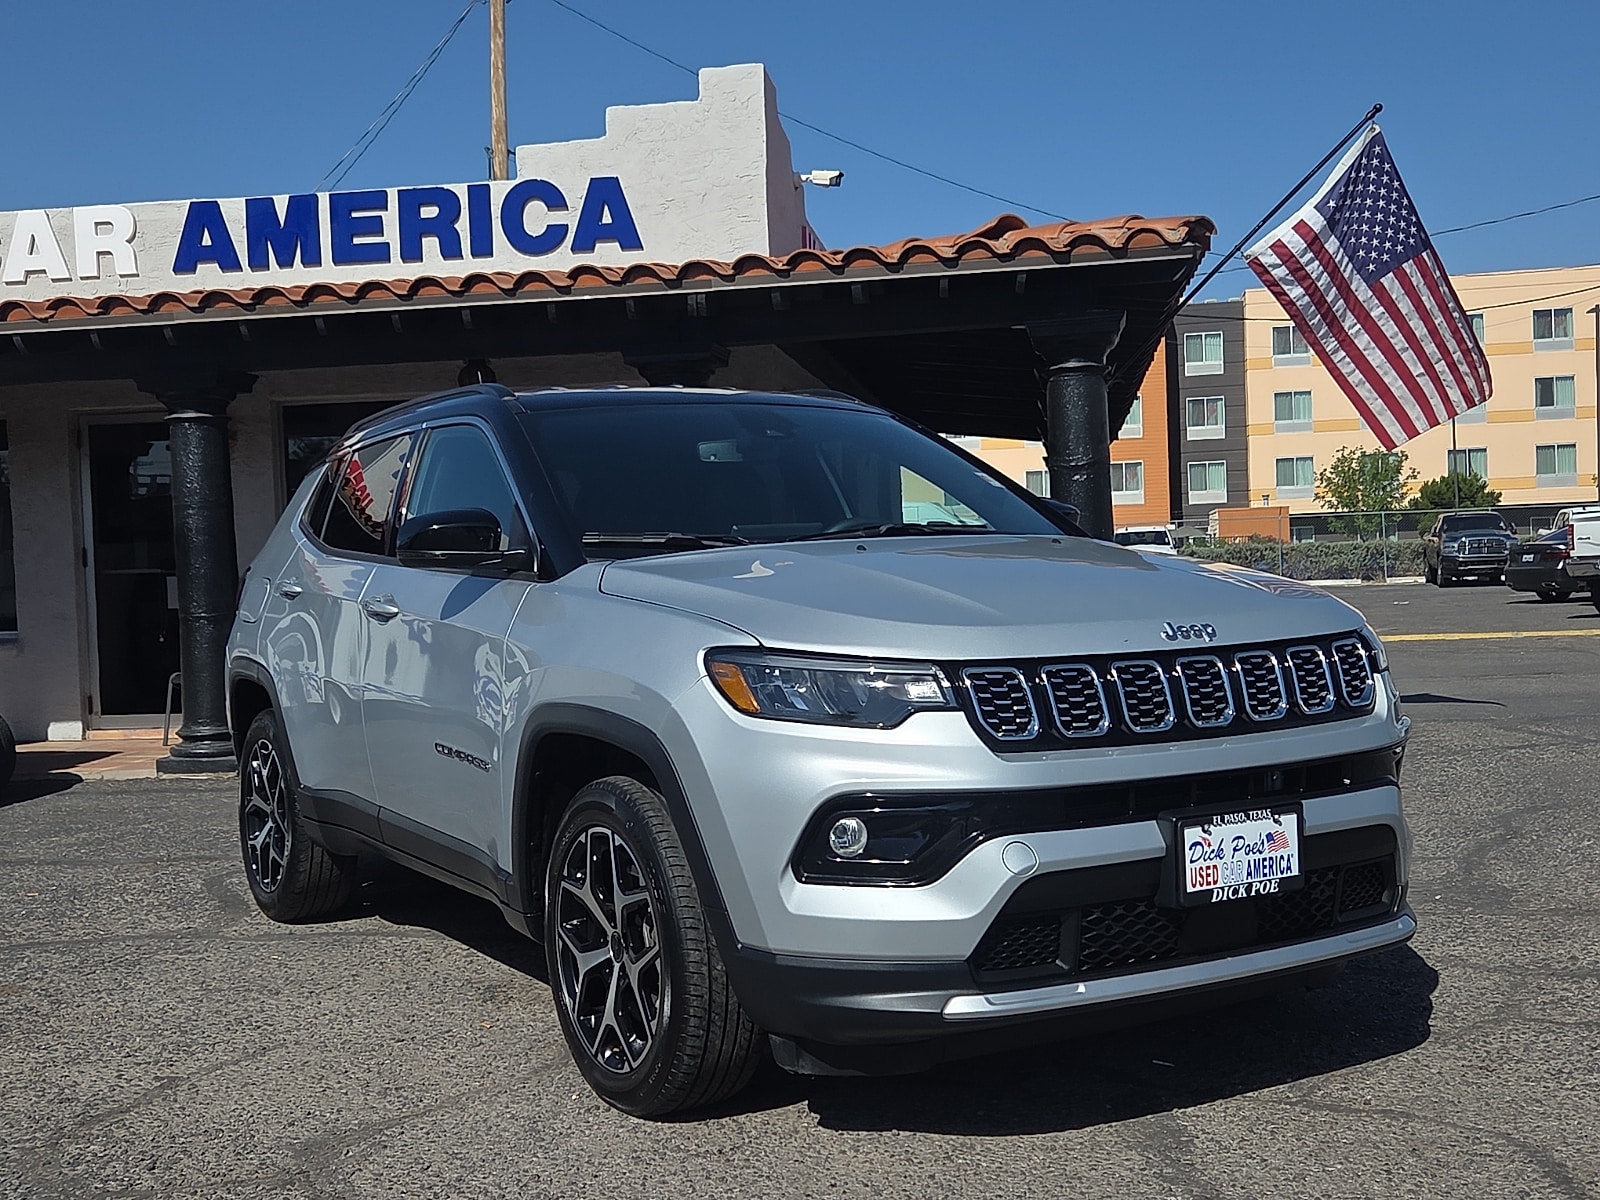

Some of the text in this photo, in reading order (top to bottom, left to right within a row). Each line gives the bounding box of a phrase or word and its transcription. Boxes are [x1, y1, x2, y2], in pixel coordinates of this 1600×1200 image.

[0, 175, 645, 286] AR AMERICA
[1160, 621, 1217, 643] Jeep
[434, 742, 491, 773] COMPASS
[1213, 816, 1222, 826] EL
[1249, 809, 1271, 820] TEXAS
[1189, 832, 1265, 864] Dick Poe's
[1191, 854, 1293, 888] USED CAR AMERICA
[1211, 879, 1279, 902] DICK POE
